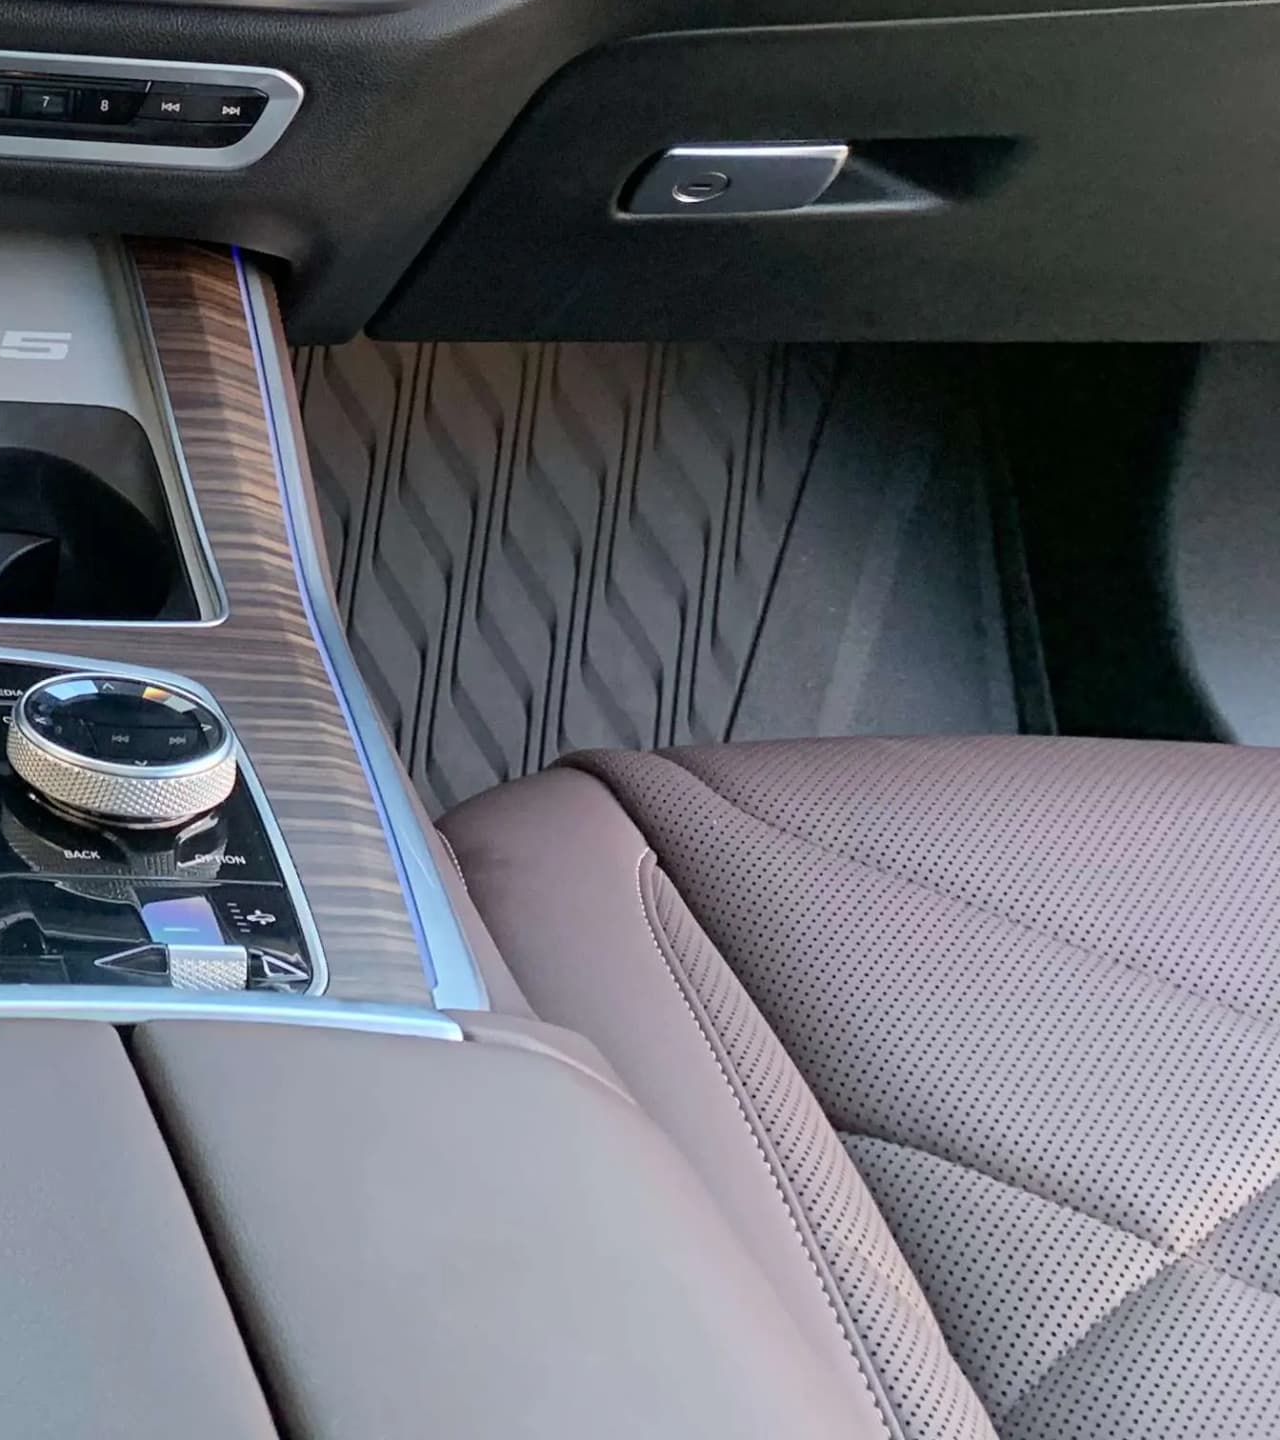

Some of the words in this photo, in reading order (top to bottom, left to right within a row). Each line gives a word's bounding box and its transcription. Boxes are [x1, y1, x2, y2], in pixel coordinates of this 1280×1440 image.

[41, 96, 50, 108] 7
[100, 99, 109, 112] 8
[64, 849, 101, 860] BACK
